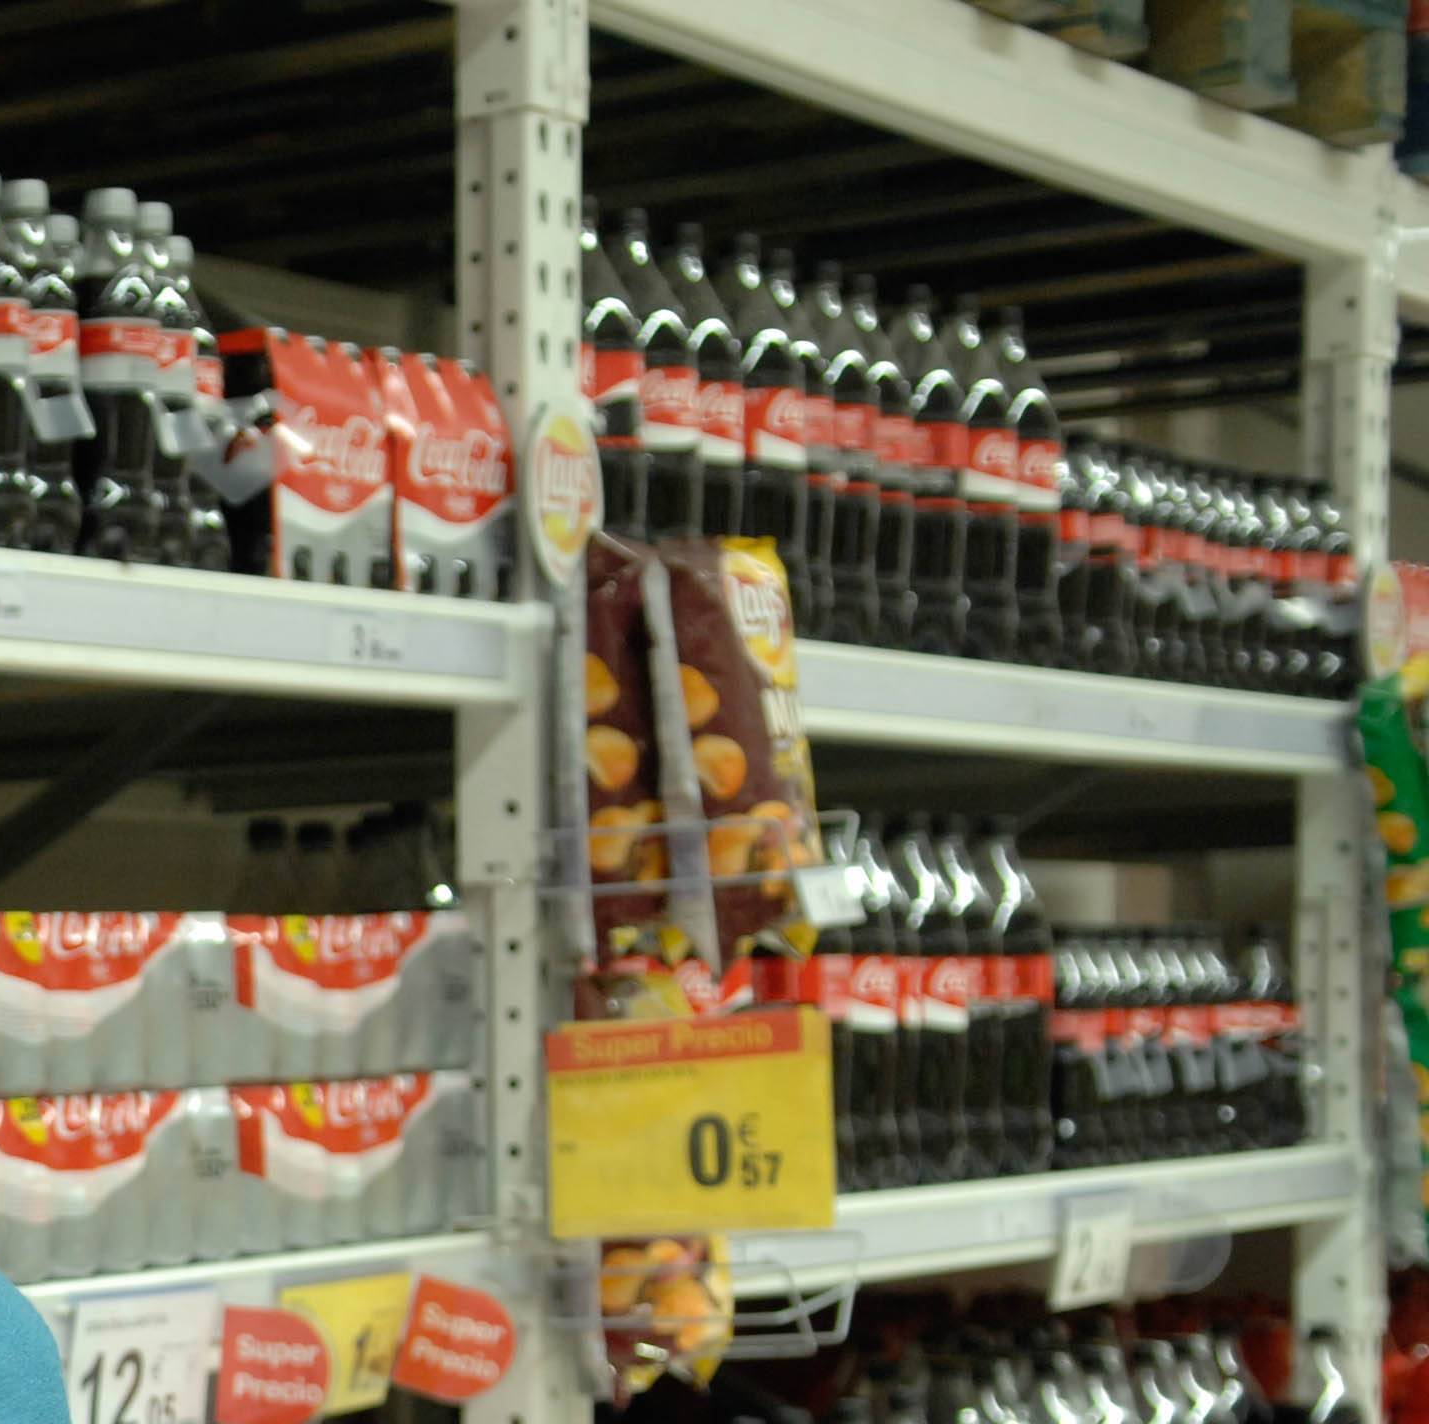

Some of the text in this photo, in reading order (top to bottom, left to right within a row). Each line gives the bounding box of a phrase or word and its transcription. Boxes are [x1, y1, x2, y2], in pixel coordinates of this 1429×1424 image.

[574, 1017, 775, 1063] Super Precio
[687, 1113, 733, 1188] 0
[741, 1152, 783, 1188] 57
[422, 1301, 508, 1345] Super
[235, 1333, 321, 1368] Super
[411, 1335, 501, 1381] Precio
[233, 1371, 325, 1404] Precio
